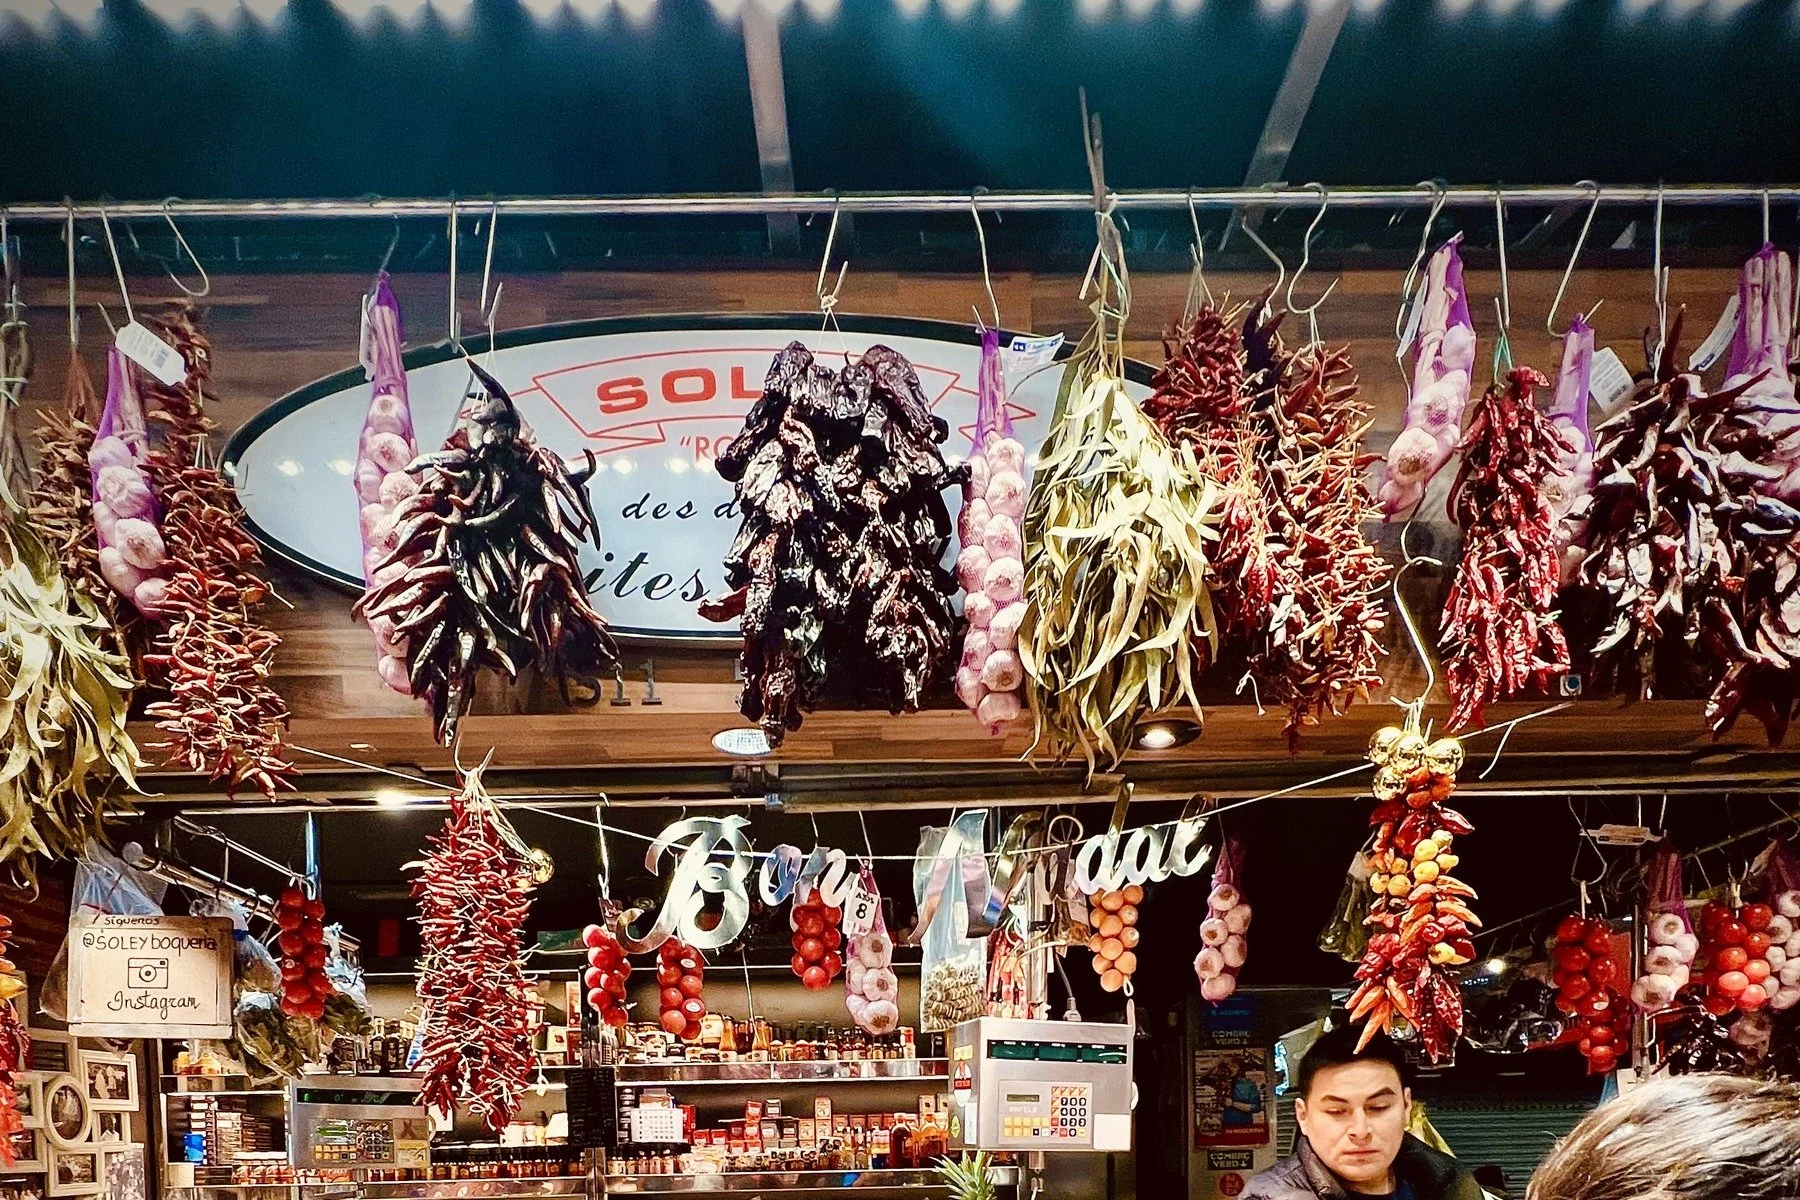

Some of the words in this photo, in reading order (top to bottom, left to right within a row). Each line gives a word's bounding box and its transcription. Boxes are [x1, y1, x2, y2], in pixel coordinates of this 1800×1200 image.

[622, 493, 697, 519] des
[615, 814, 862, 955] Bon
[855, 903, 868, 919] 8
[106, 990, 201, 1021] Instagram
